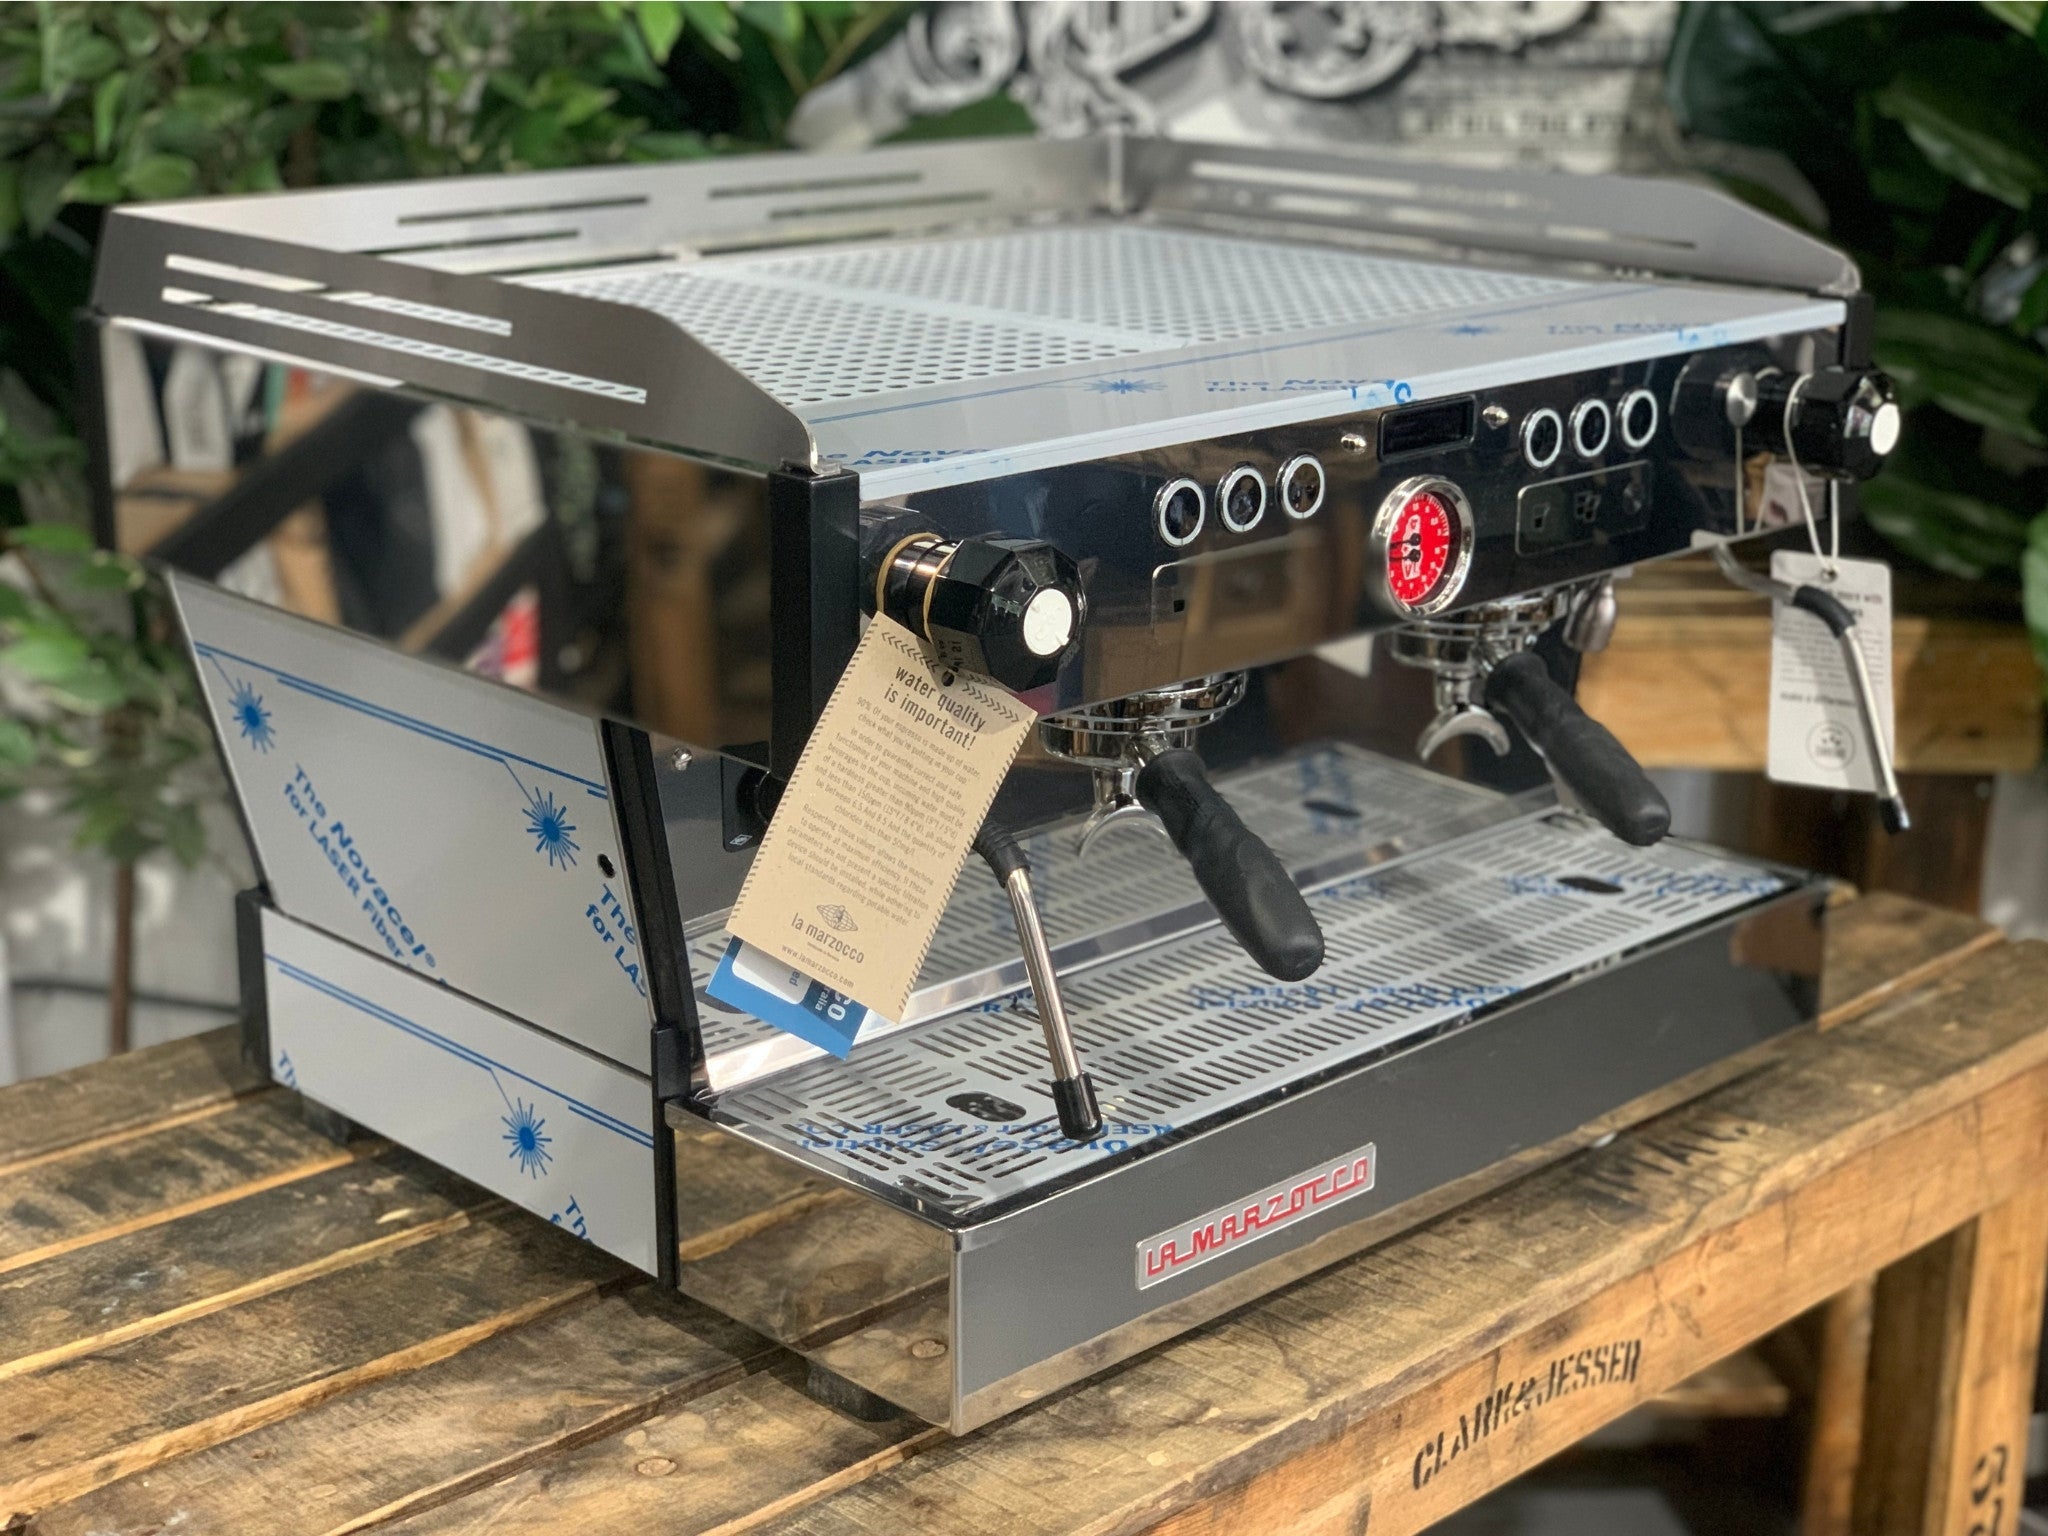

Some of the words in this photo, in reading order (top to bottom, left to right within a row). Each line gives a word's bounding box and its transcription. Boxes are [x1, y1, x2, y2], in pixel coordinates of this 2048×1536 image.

[883, 684, 900, 704] is
[900, 693, 976, 752] important!
[895, 666, 936, 700] water
[938, 690, 987, 732] quality
[296, 763, 327, 819] The
[284, 783, 308, 818] for
[309, 820, 361, 898] LASER
[362, 898, 405, 958] Fiber
[585, 903, 615, 942] for
[790, 912, 806, 932] la
[805, 923, 866, 965] marzocco
[781, 945, 855, 988] www.lamarzocco.com
[1146, 1239, 1191, 1277] LA
[1191, 1156, 1370, 1254] MARZOCCO
